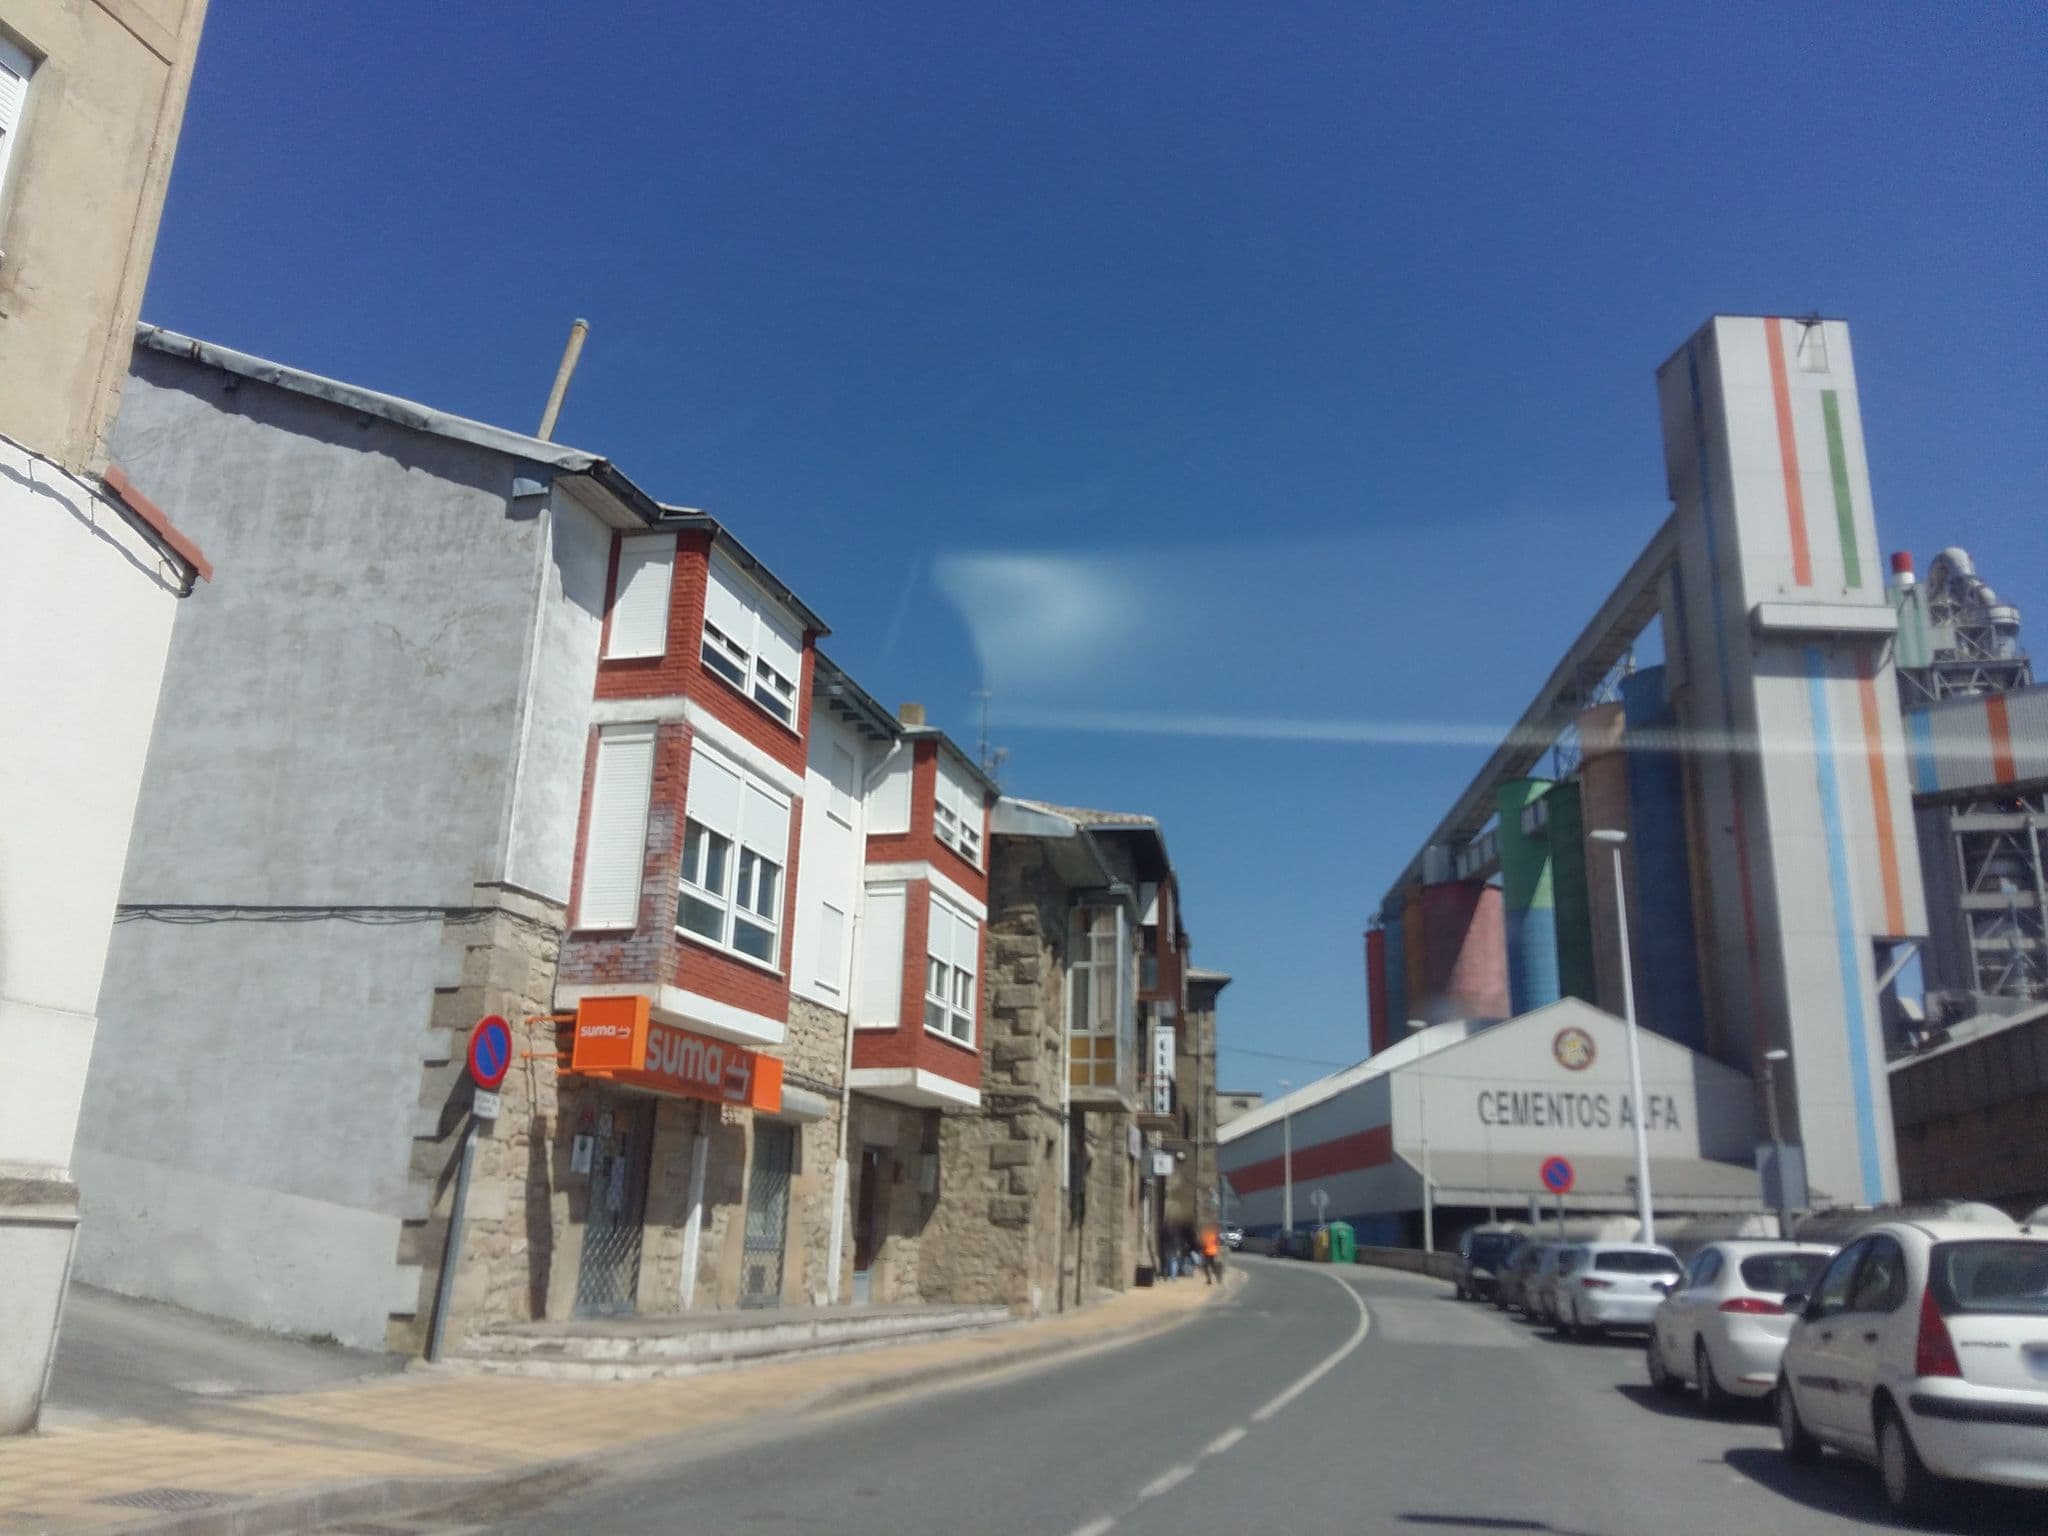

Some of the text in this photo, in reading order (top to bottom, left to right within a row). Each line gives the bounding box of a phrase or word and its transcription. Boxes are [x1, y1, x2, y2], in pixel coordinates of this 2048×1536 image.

[580, 1024, 617, 1037] suma
[647, 1029, 722, 1085] suma
[1478, 1090, 1681, 1130] CEMENTOS AFA
